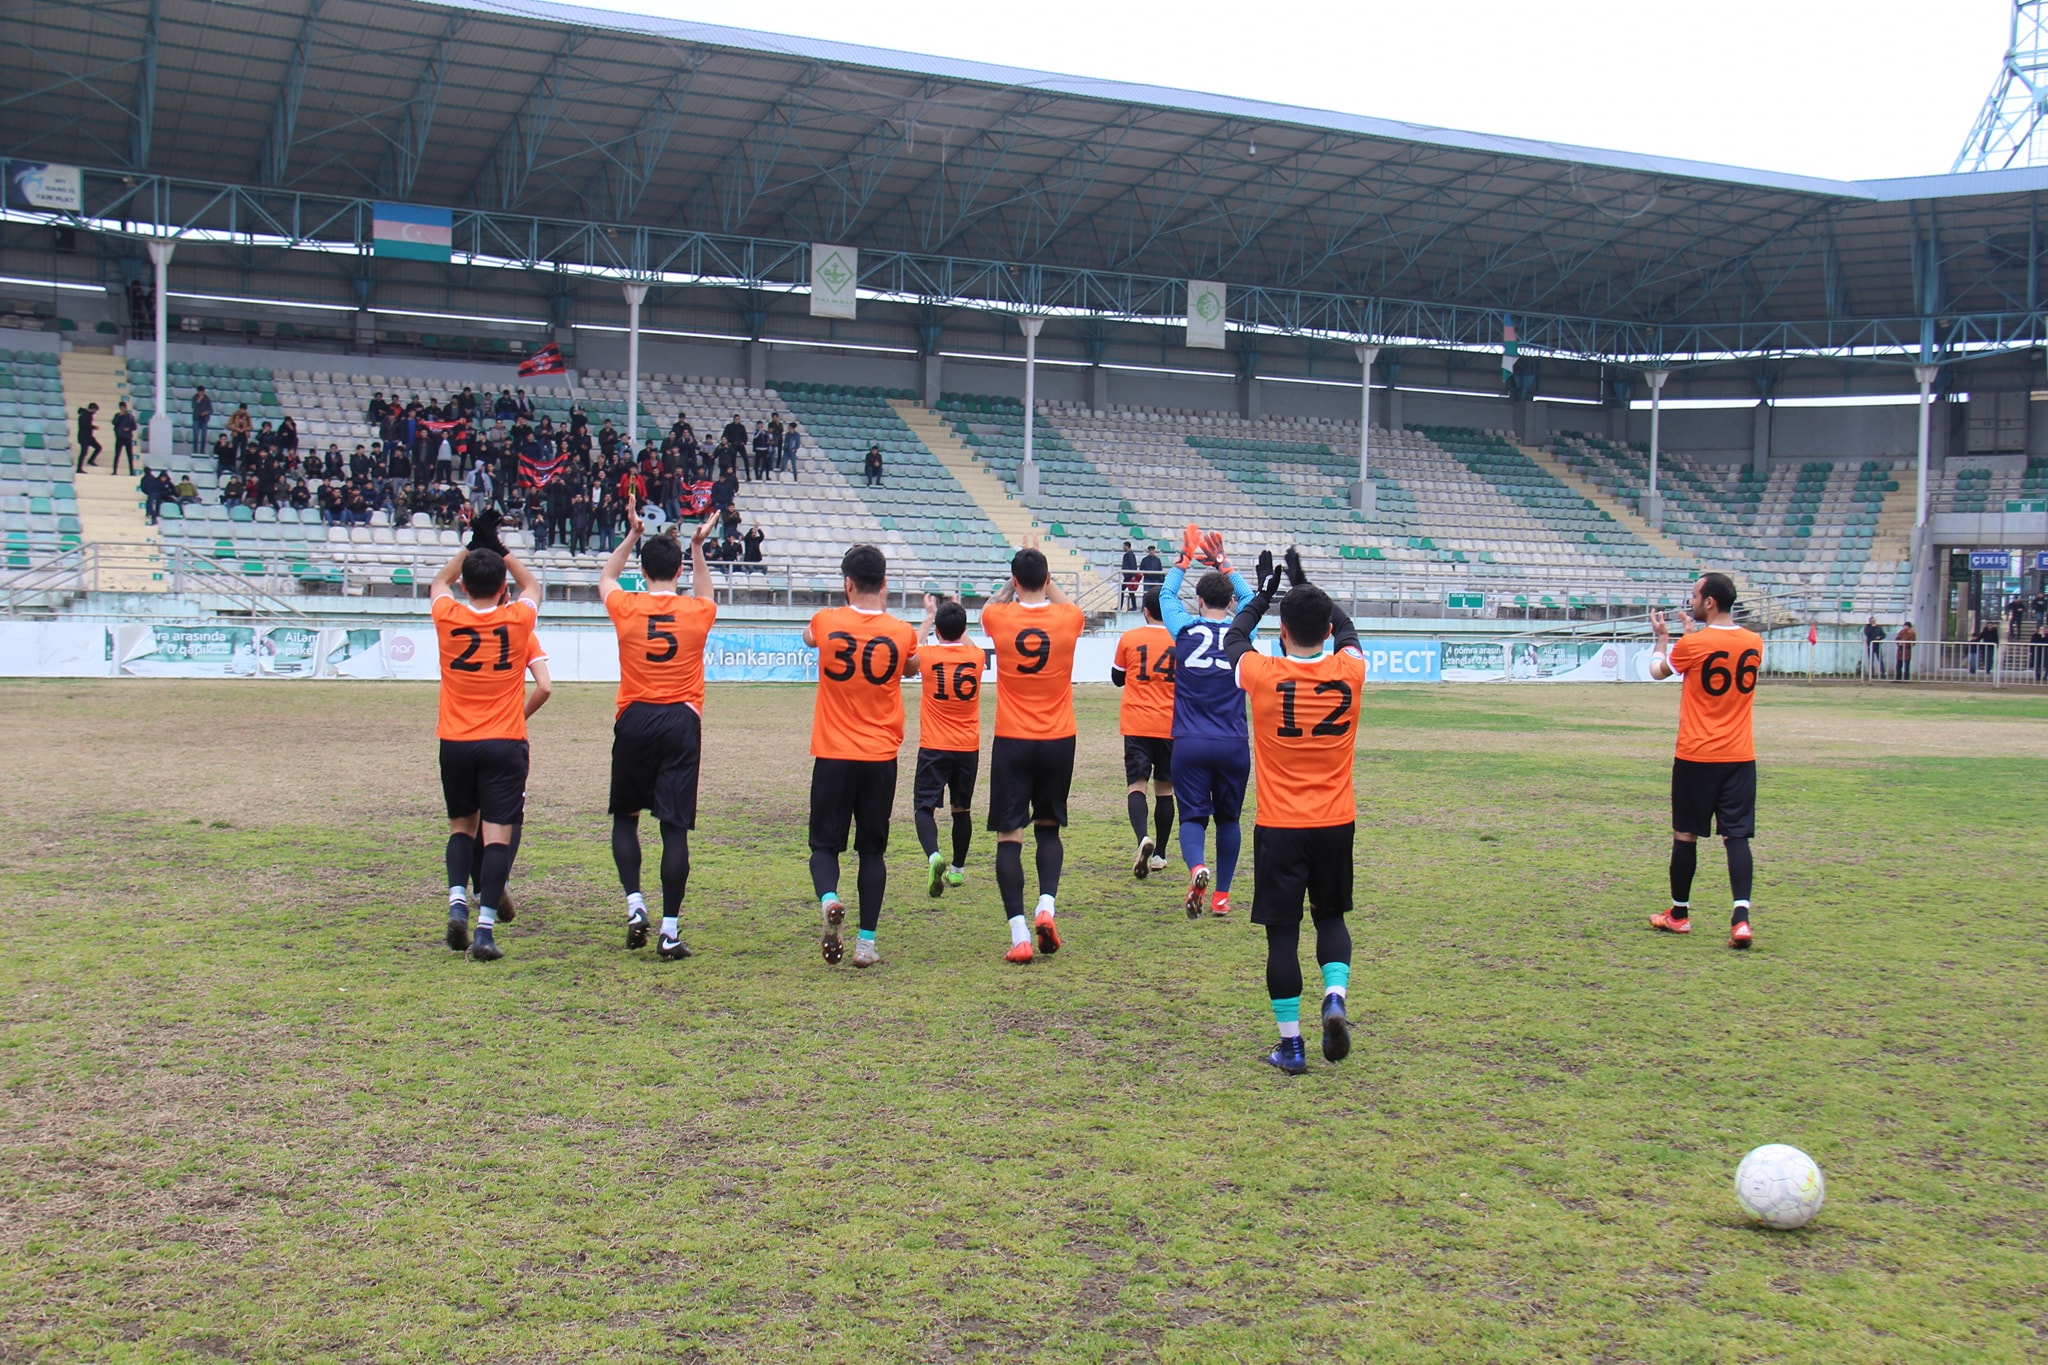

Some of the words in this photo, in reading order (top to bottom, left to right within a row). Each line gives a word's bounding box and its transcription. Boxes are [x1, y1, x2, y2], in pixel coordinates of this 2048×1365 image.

[1972, 556, 2007, 566] ÇIXIŞ
[635, 579, 647, 591] K
[1462, 597, 1469, 607] L
[172, 630, 226, 641] arasında
[391, 643, 413, 653] nar
[450, 624, 512, 672] 21
[646, 614, 678, 662] 5
[1015, 628, 1050, 674] 9
[824, 631, 899, 686] 30
[1136, 644, 1176, 682] 14
[1701, 648, 1761, 697] 66
[931, 662, 977, 701] 16
[1276, 679, 1352, 738] 12
